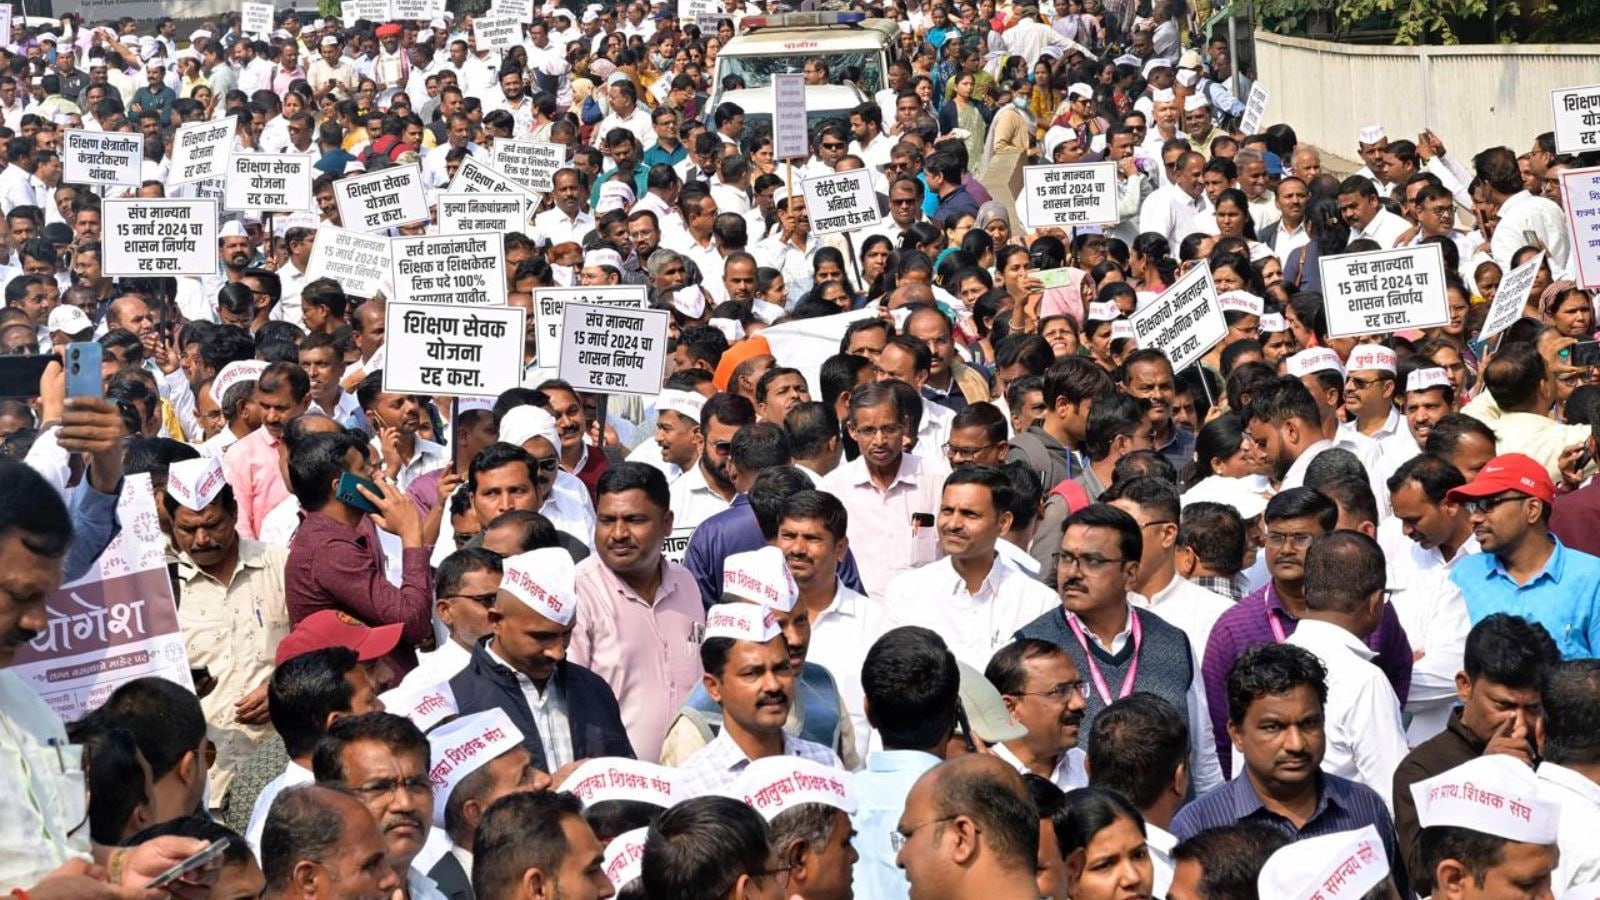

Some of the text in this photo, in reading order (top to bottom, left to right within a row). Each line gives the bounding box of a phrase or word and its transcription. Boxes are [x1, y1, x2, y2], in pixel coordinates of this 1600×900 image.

[69, 134, 139, 152] शिक्षण क्षेत्रातील
[182, 126, 228, 147] शिक्षण सेवक
[77, 151, 128, 166] कंत्राटीकरण
[190, 145, 214, 160] योजना
[236, 161, 300, 174] शिक्षण सेवक
[462, 163, 495, 190] शिक्षण
[1044, 170, 1095, 182] संच मान्यता
[251, 175, 286, 190] योजना
[346, 174, 410, 198] शिक्षण सेवक
[836, 177, 860, 193] परीक्षा
[1036, 183, 1105, 196] 15 मार्च 2024 चा
[247, 193, 288, 205] रद्द करा.
[364, 191, 400, 210] योजना
[1043, 194, 1100, 209] शासन निर्णय
[128, 204, 191, 219] संच मान्यता
[365, 208, 407, 227] रद्द करा.
[443, 202, 466, 217] जुन्या
[815, 206, 875, 230] करण्यात येऊ नये
[1054, 211, 1090, 222] रद्द करा.
[117, 221, 202, 236] 15 मार्च 2024 चा
[458, 217, 506, 230] संच मान्यता
[124, 238, 196, 254] शासन निर्णय
[336, 233, 385, 252] संच मान्यता
[406, 240, 487, 256] सर्व शाळांमधील
[138, 257, 181, 271] रद्द करा.
[324, 246, 390, 268] 15 मार्च 2024 चा
[400, 256, 496, 275] शिक्षक व शिक्षकेतर
[1347, 255, 1414, 276] संच मान्यता
[326, 261, 382, 279] शासन निर्णय
[411, 273, 486, 290] रिक्त पदे 100%
[1338, 272, 1428, 295] 15 मार्च 2024 चा
[1348, 290, 1423, 312] शासन निर्णय
[403, 310, 507, 339] शिक्षण सेवक
[586, 309, 645, 331] संच मान्यता
[1365, 310, 1410, 327] रद्द करा.
[426, 337, 483, 362] योजना
[574, 330, 653, 351] 15 मार्च 2024 चा
[1182, 335, 1200, 355] करा.
[579, 350, 645, 369] शासन निर्णय
[420, 366, 485, 388] रद्द करा.
[589, 370, 628, 387] रद्द करा.
[738, 569, 762, 593] शिक्षक
[520, 572, 547, 602] शिक्षक
[547, 594, 562, 613] संघ
[445, 736, 486, 765] शिक्षक
[483, 727, 508, 743] संघ
[608, 767, 648, 788] शिक्षक
[651, 776, 670, 795] संघ
[754, 777, 795, 808] तालुका
[793, 771, 830, 791] शिक्षक
[1509, 798, 1532, 823] संघ
